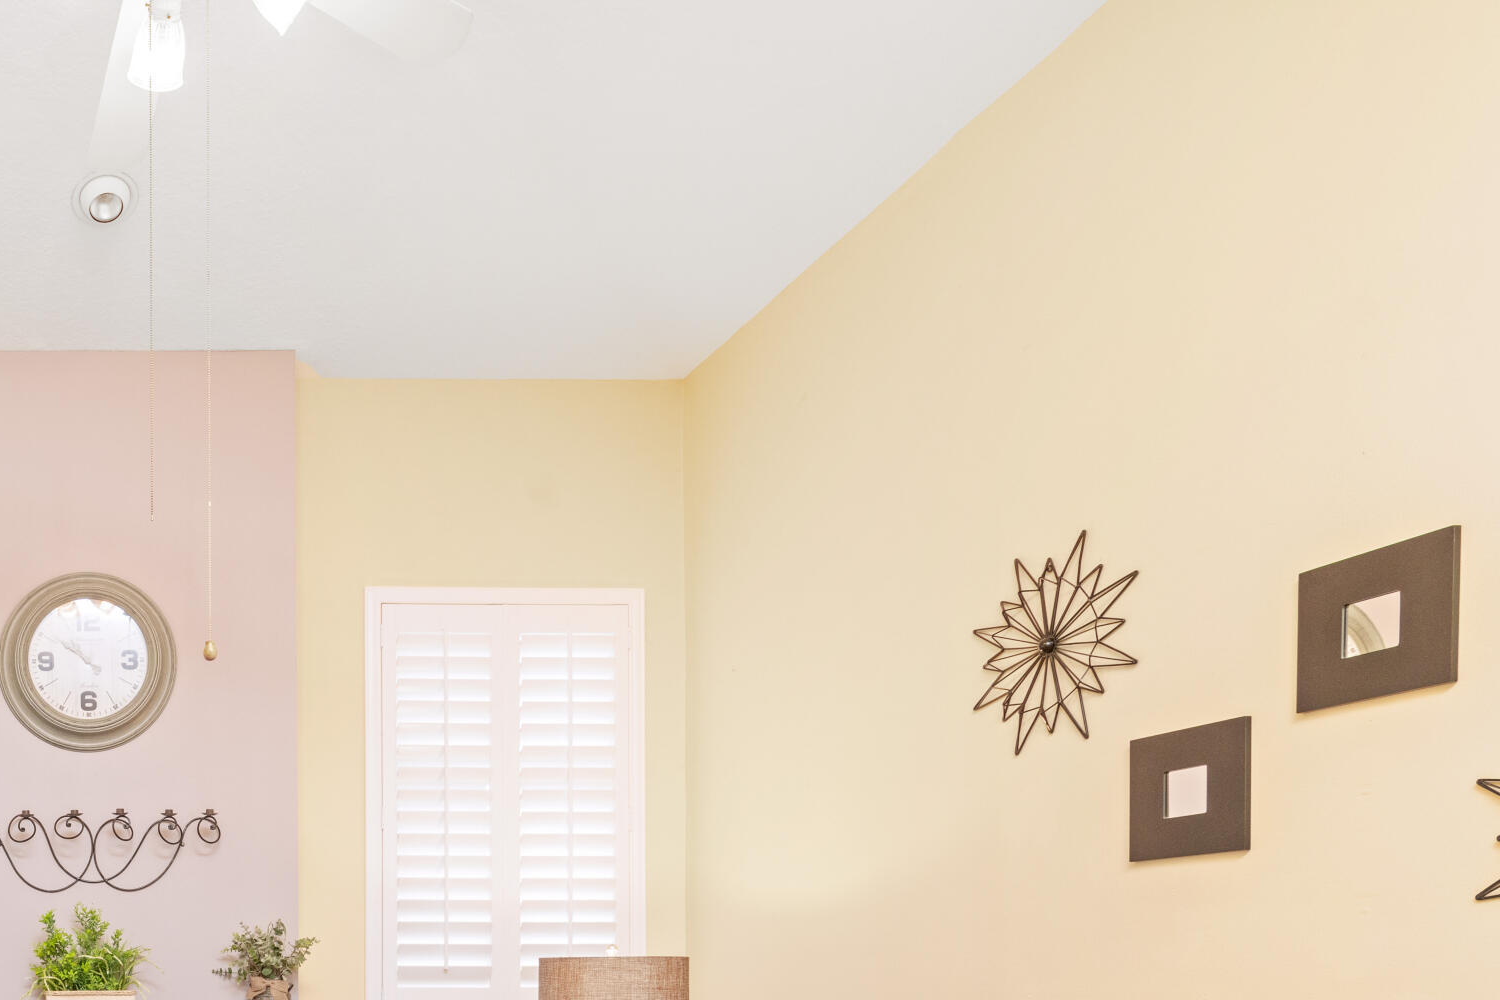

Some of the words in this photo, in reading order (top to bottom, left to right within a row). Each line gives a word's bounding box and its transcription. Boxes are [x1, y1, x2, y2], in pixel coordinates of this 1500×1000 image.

[76, 612, 102, 632] 12
[37, 651, 55, 671] 9
[120, 650, 139, 670] 3
[80, 691, 98, 711] 6
